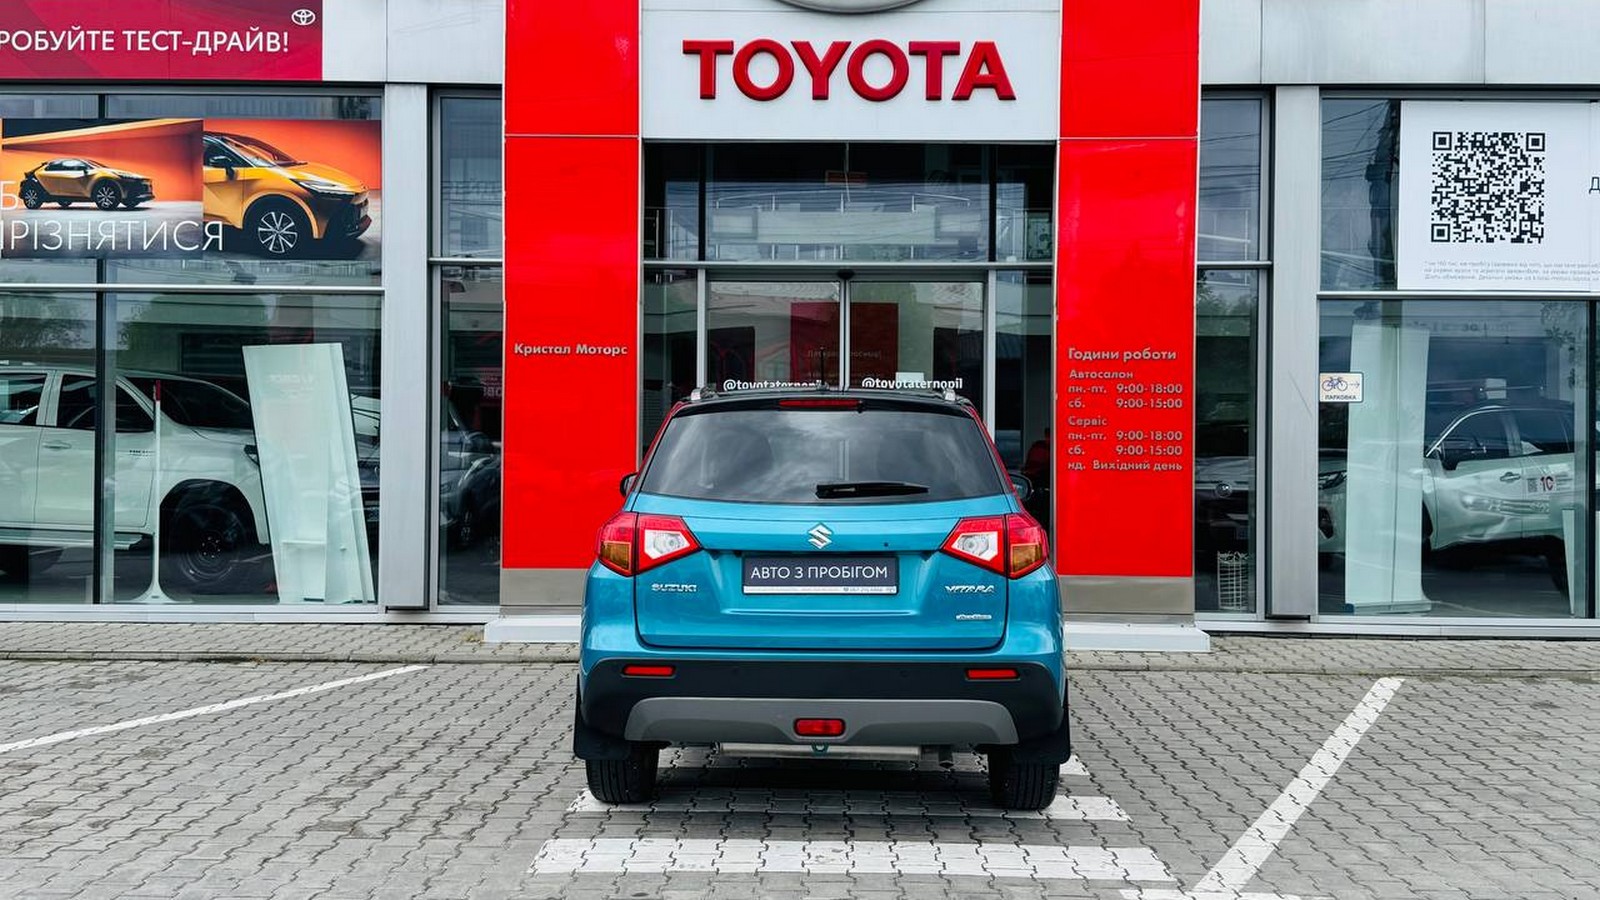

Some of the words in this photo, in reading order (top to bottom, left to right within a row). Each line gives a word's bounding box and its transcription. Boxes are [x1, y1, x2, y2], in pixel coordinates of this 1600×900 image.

[0, 25, 115, 52] РОБУЙТЕ
[122, 26, 289, 56] ТЕСТ-ДРАЙВ!
[682, 39, 1017, 102] TOYOTA
[0, 219, 224, 251] РІЗНЯТИСЯ
[514, 343, 572, 357] Кристал
[576, 343, 628, 356] Моторс
[1068, 348, 1119, 361] Години
[1123, 347, 1177, 363] роботи
[1069, 369, 1134, 379] Автосалон
[1068, 384, 1107, 394] пн.-пт.
[1116, 384, 1183, 394] 9:00-18:00
[1068, 398, 1086, 409] сб.
[1116, 398, 1183, 409] 9:00-15:00
[1068, 415, 1108, 428] Сервіс
[1068, 431, 1107, 441] пн.-пт.
[1116, 430, 1183, 441] 9:00-18:00
[1068, 444, 1086, 455] сб.
[1116, 445, 1183, 456] 9:00-15:00
[1068, 462, 1086, 470] нд.
[1093, 459, 1151, 470] Вихідний
[1153, 462, 1183, 472] день
[750, 565, 791, 581] АВТО
[794, 565, 804, 580] З
[807, 564, 888, 581] ПРОБІГОМ
[651, 582, 697, 592] SUZUKI
[944, 584, 996, 594] VITARA
